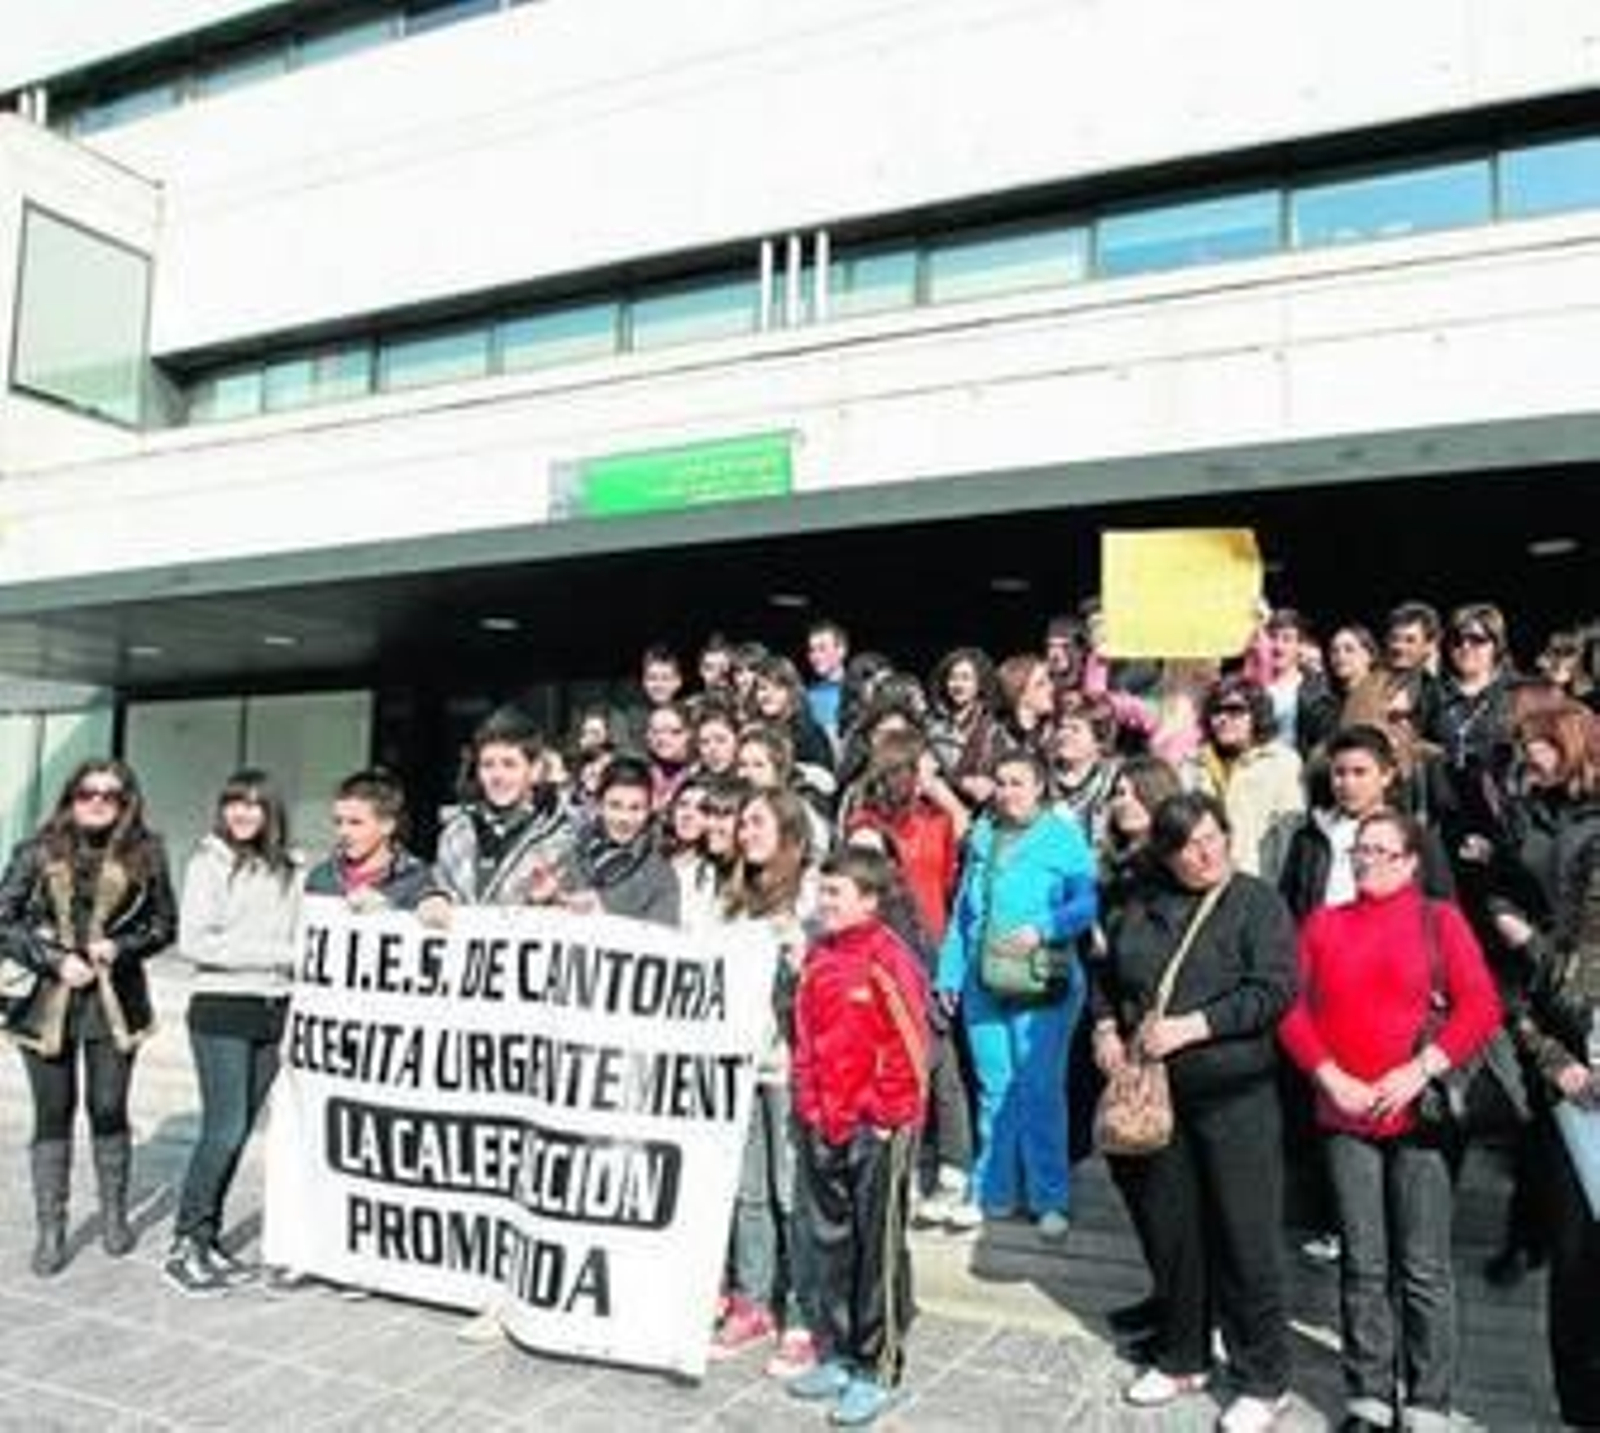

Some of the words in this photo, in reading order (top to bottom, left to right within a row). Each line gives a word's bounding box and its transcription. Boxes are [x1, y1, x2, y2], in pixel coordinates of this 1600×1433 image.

[303, 926, 332, 987] EL
[345, 930, 449, 997] I.E.S.
[460, 938, 510, 1000] DE
[518, 940, 724, 1021] CANTORIA
[290, 1011, 424, 1088] ECESITA
[340, 1107, 382, 1175] LA
